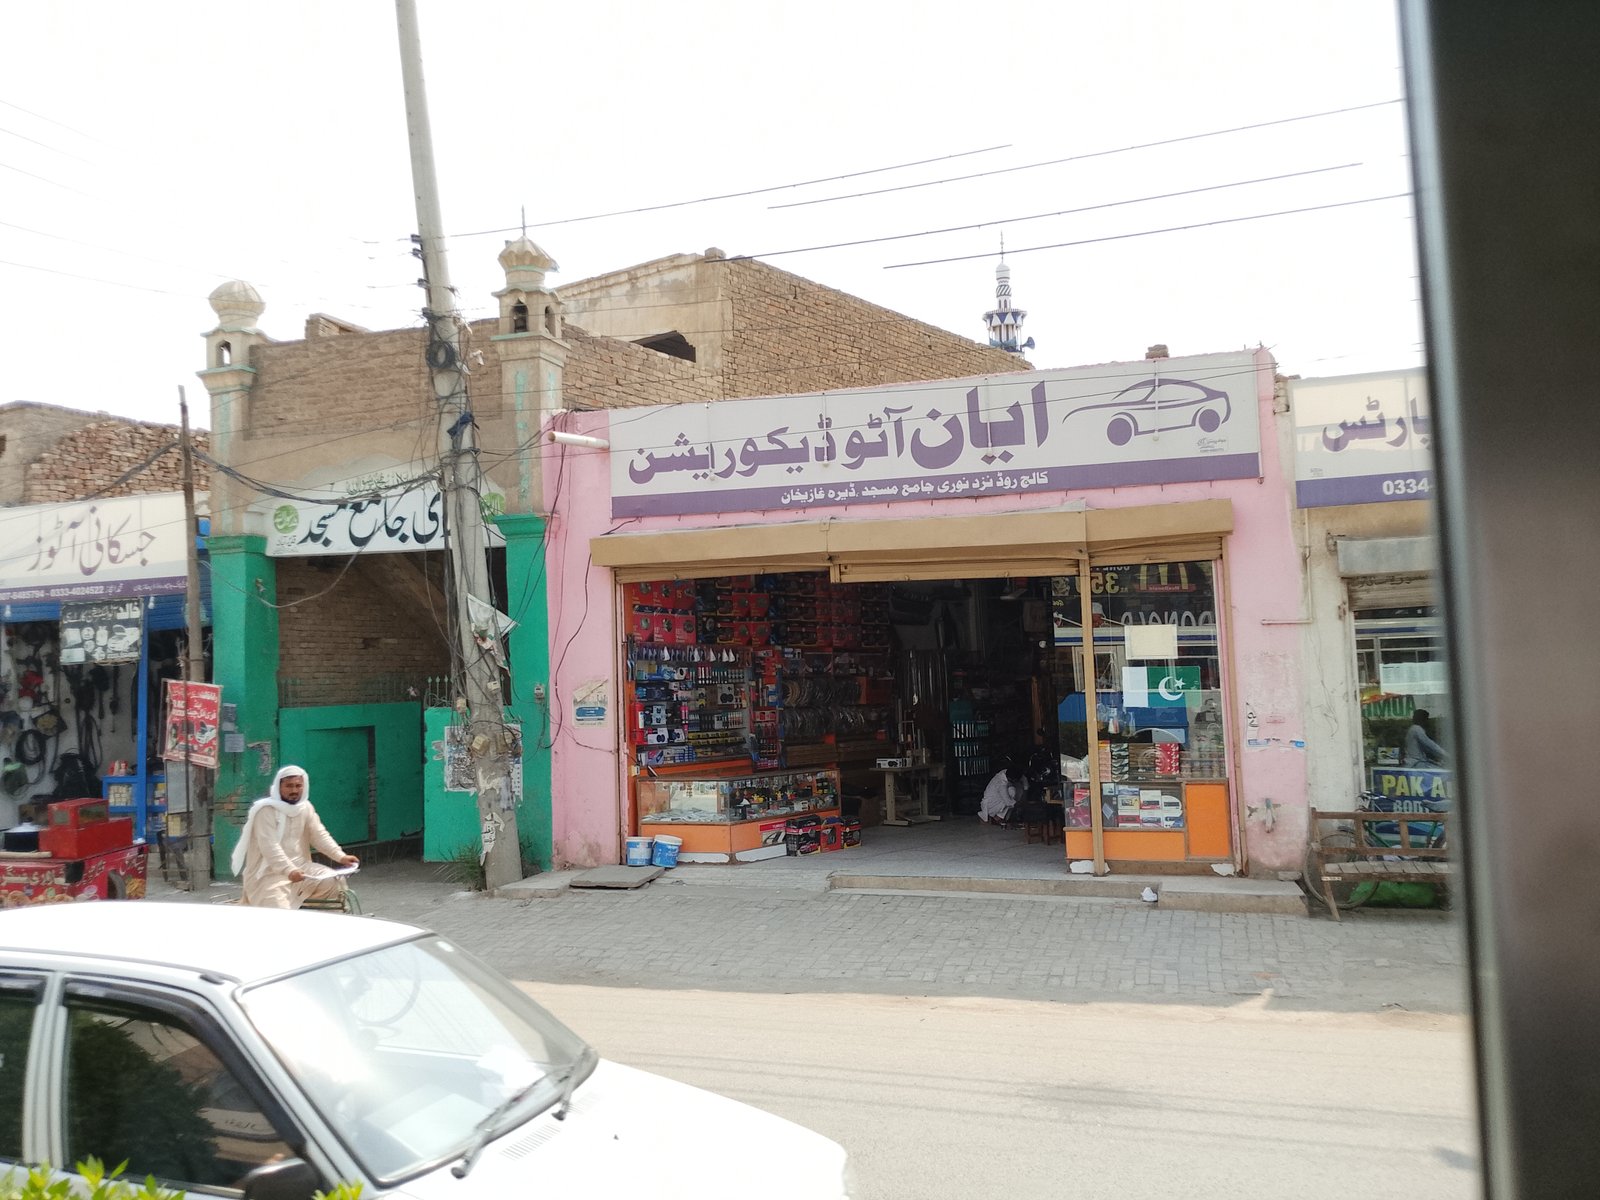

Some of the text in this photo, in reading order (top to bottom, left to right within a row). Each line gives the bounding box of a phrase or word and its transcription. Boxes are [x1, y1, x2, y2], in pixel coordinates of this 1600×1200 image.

[629, 380, 1049, 484] ایان آٹو ڈیکوریشن
[937, 477, 969, 494] نوری
[972, 476, 993, 490] نزد
[996, 470, 1018, 490] روڈ
[1020, 471, 1049, 487] کالج
[861, 484, 899, 498] مسجد
[902, 480, 934, 497] جامع
[1381, 774, 1425, 797] PAK
